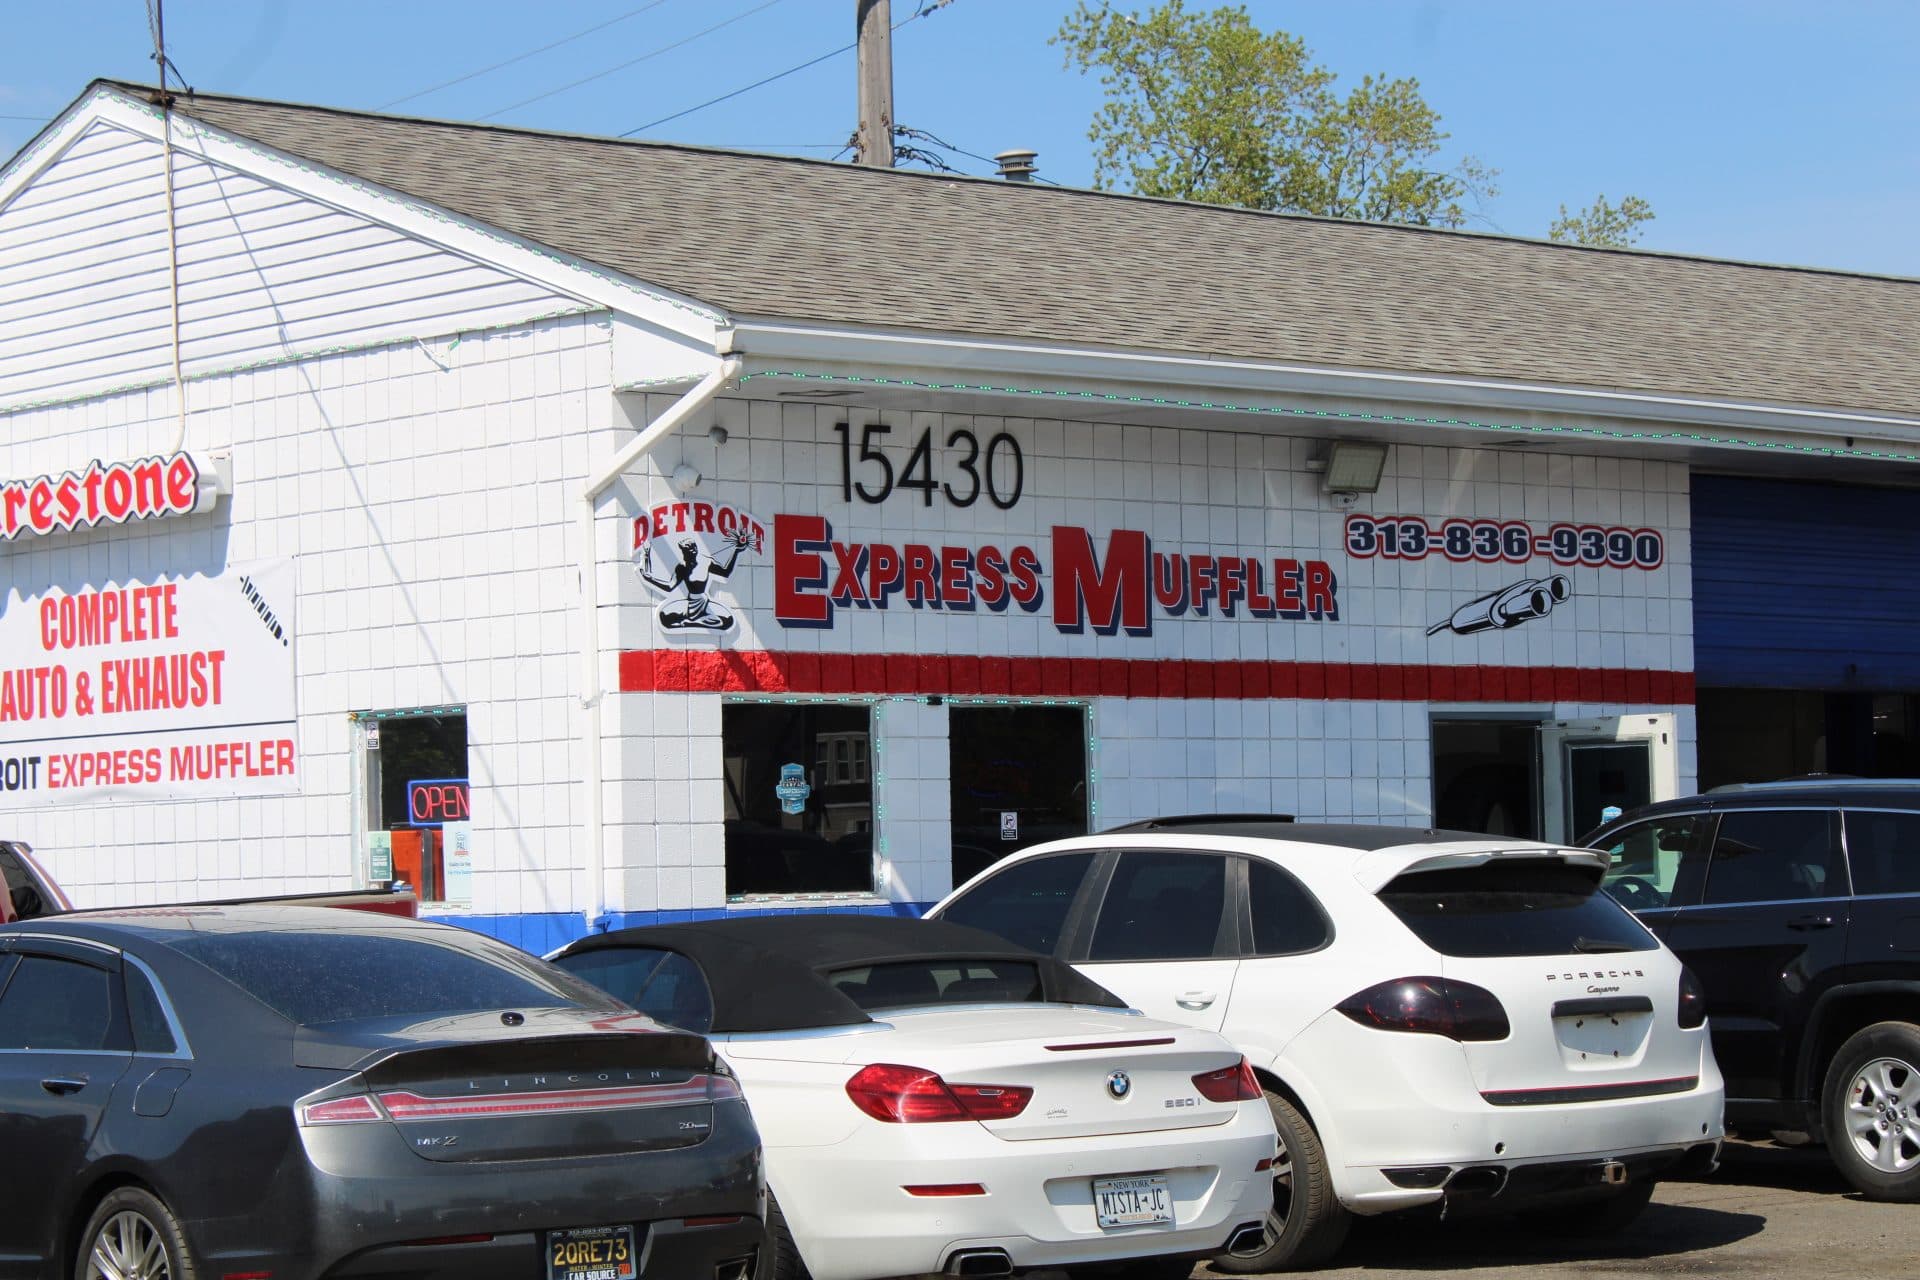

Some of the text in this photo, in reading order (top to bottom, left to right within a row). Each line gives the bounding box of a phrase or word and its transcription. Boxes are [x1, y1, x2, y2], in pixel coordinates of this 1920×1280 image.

[834, 422, 1023, 510] 15430
[0, 455, 194, 534] restone
[633, 502, 764, 556] DETROIT
[1345, 515, 1664, 571] 313-836-9390
[774, 514, 1340, 637] EXPRESS MUFFLER
[40, 583, 179, 651] COMPLETE
[0, 650, 225, 722] AUTO & EXHAUST
[0, 739, 295, 792] OIT EXPRESS MUFFLER
[412, 785, 470, 819] OPEN
[1546, 969, 1644, 981] PORSCHE
[469, 1071, 661, 1089] LINCOLN
[416, 1135, 457, 1147] MKZ
[1131, 1180, 1150, 1188] YORK
